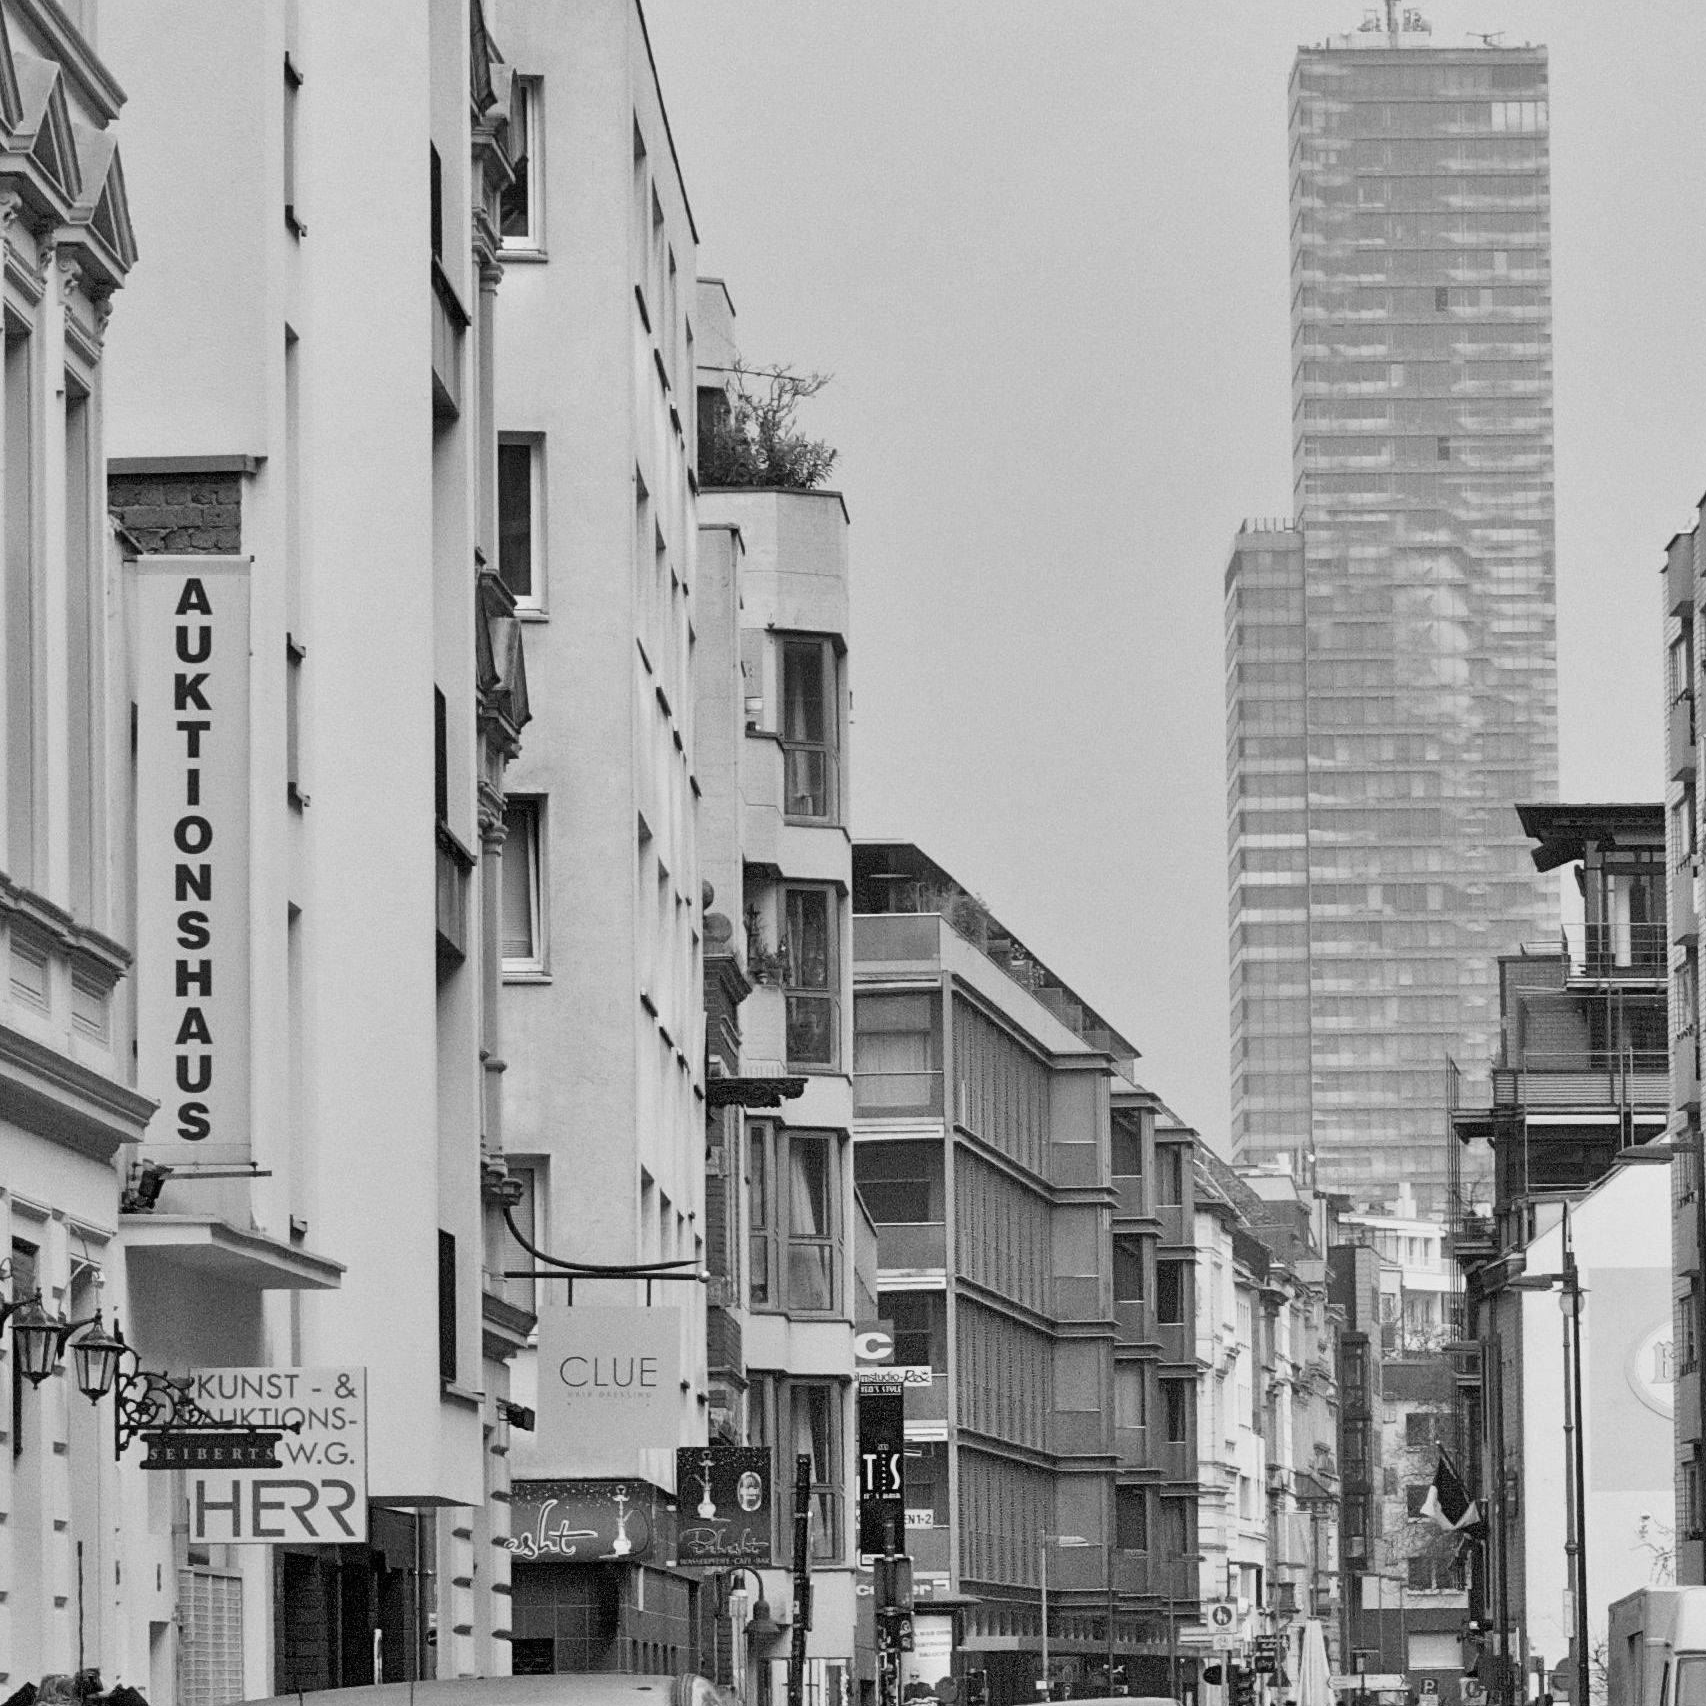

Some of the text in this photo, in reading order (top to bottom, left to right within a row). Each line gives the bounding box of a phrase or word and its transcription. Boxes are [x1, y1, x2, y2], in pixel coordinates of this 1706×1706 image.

[173, 577, 214, 1141] AUKTIONSHAUS
[198, 1373, 300, 1400] KUNST
[559, 1356, 658, 1387] CLUE
[149, 1447, 276, 1461] SEIBERTS
[196, 1479, 357, 1538] HERR
